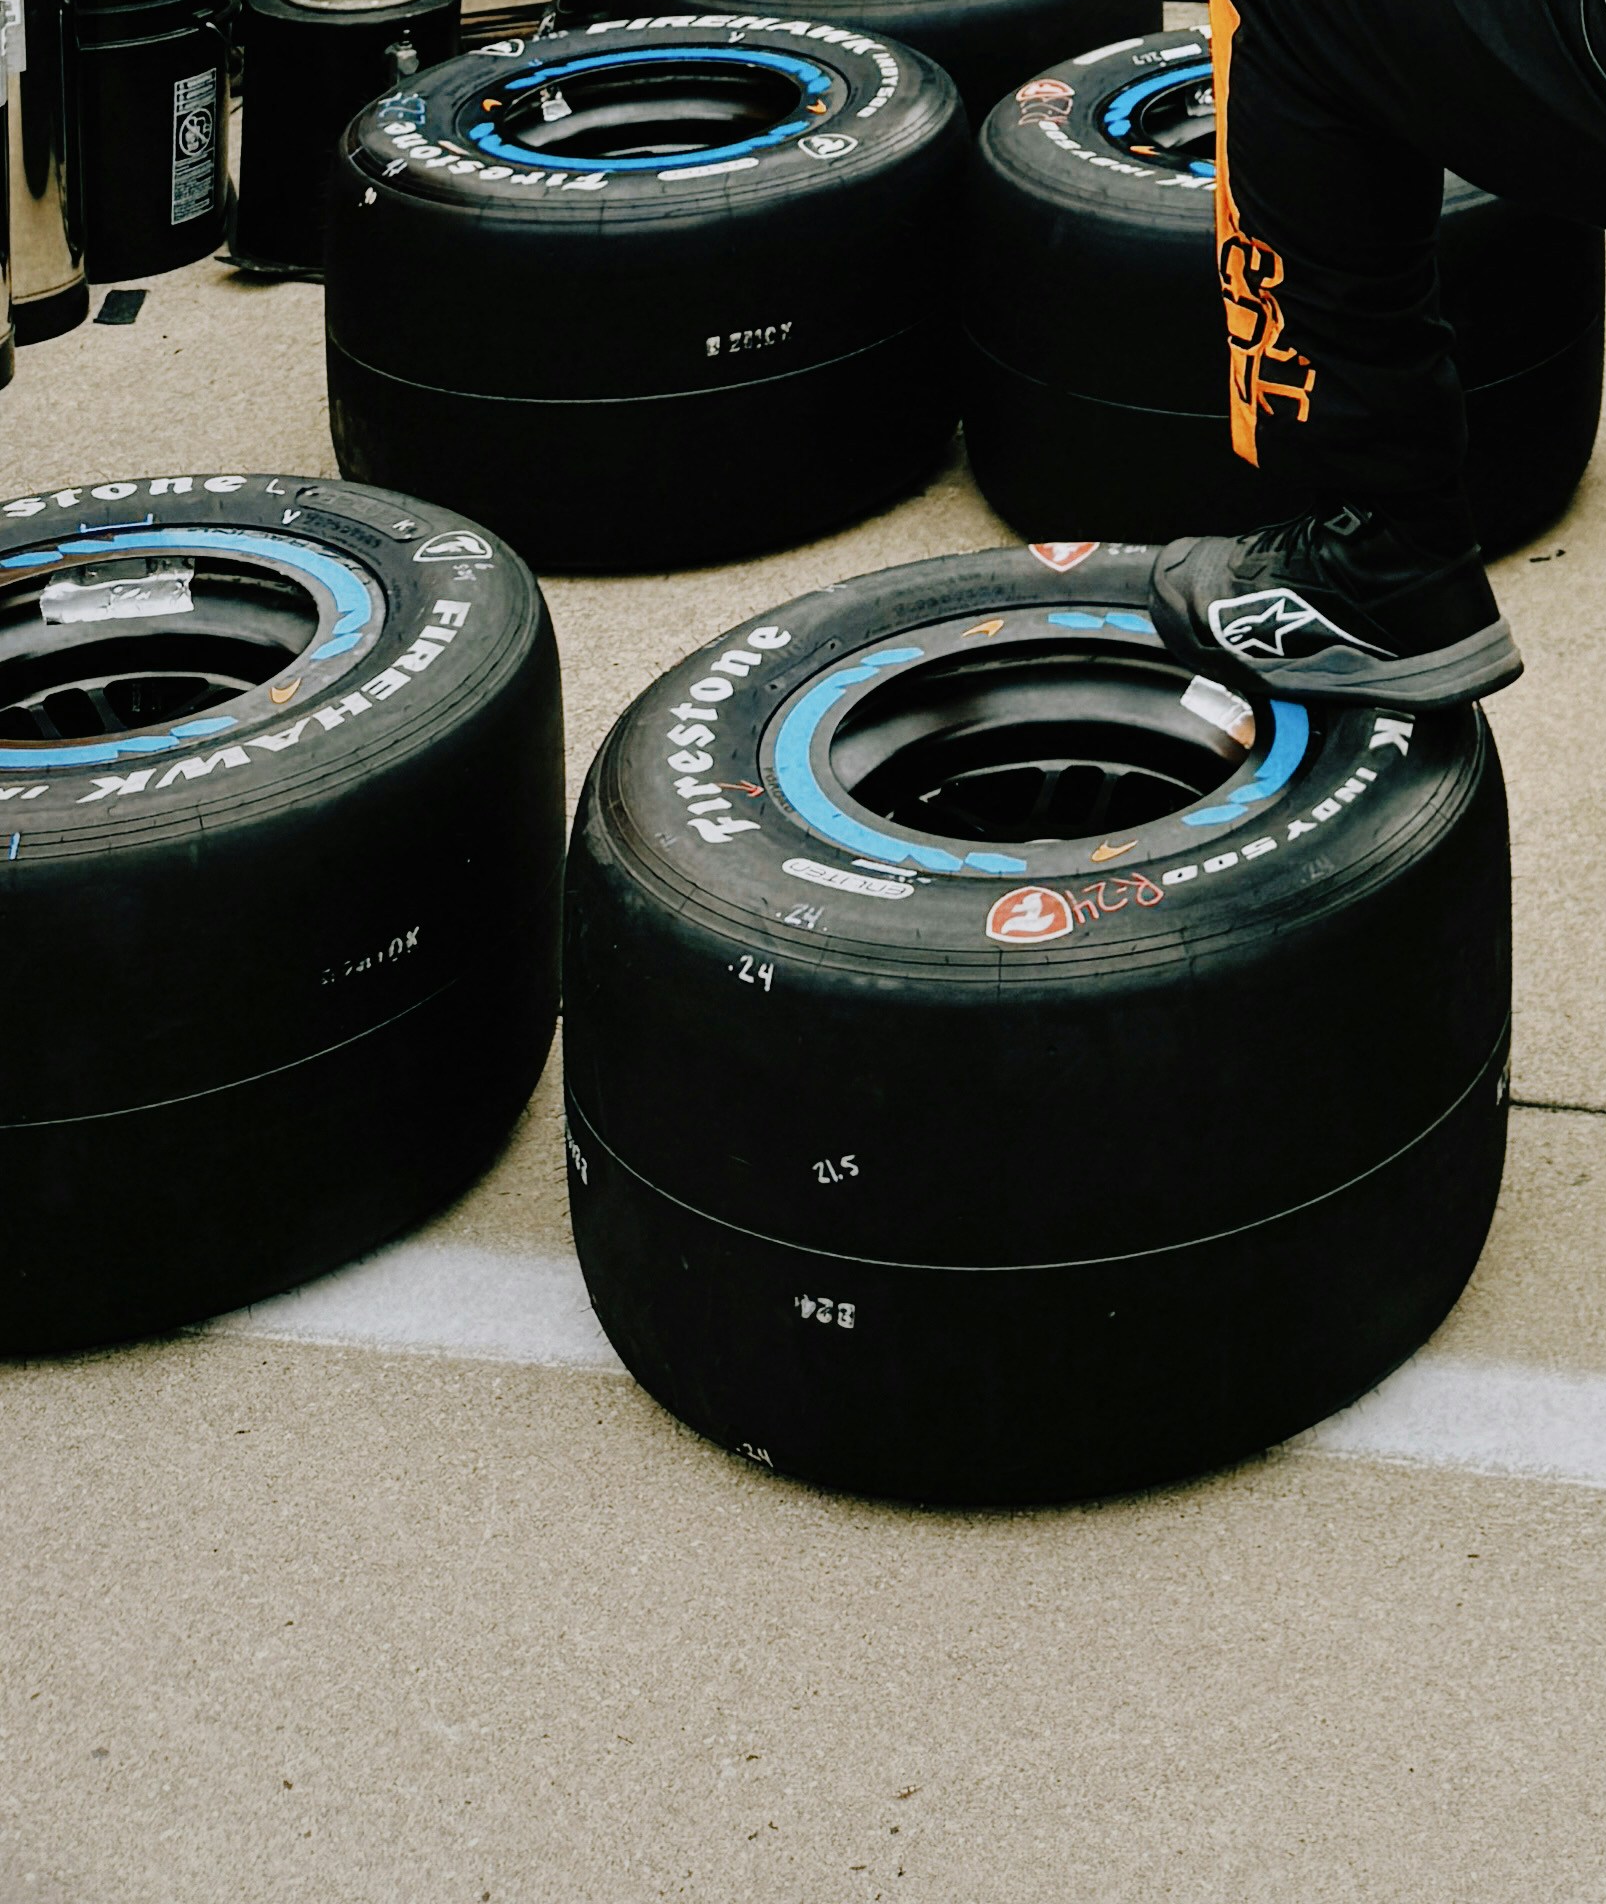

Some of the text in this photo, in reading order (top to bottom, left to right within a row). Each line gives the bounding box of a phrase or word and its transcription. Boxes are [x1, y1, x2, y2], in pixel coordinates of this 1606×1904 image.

[586, 14, 888, 55] FIREHAWK
[383, 121, 609, 191] Firestone
[76, 599, 472, 804] FIREHAWK
[666, 624, 793, 845] Firestone
[1286, 766, 1379, 841] INDY
